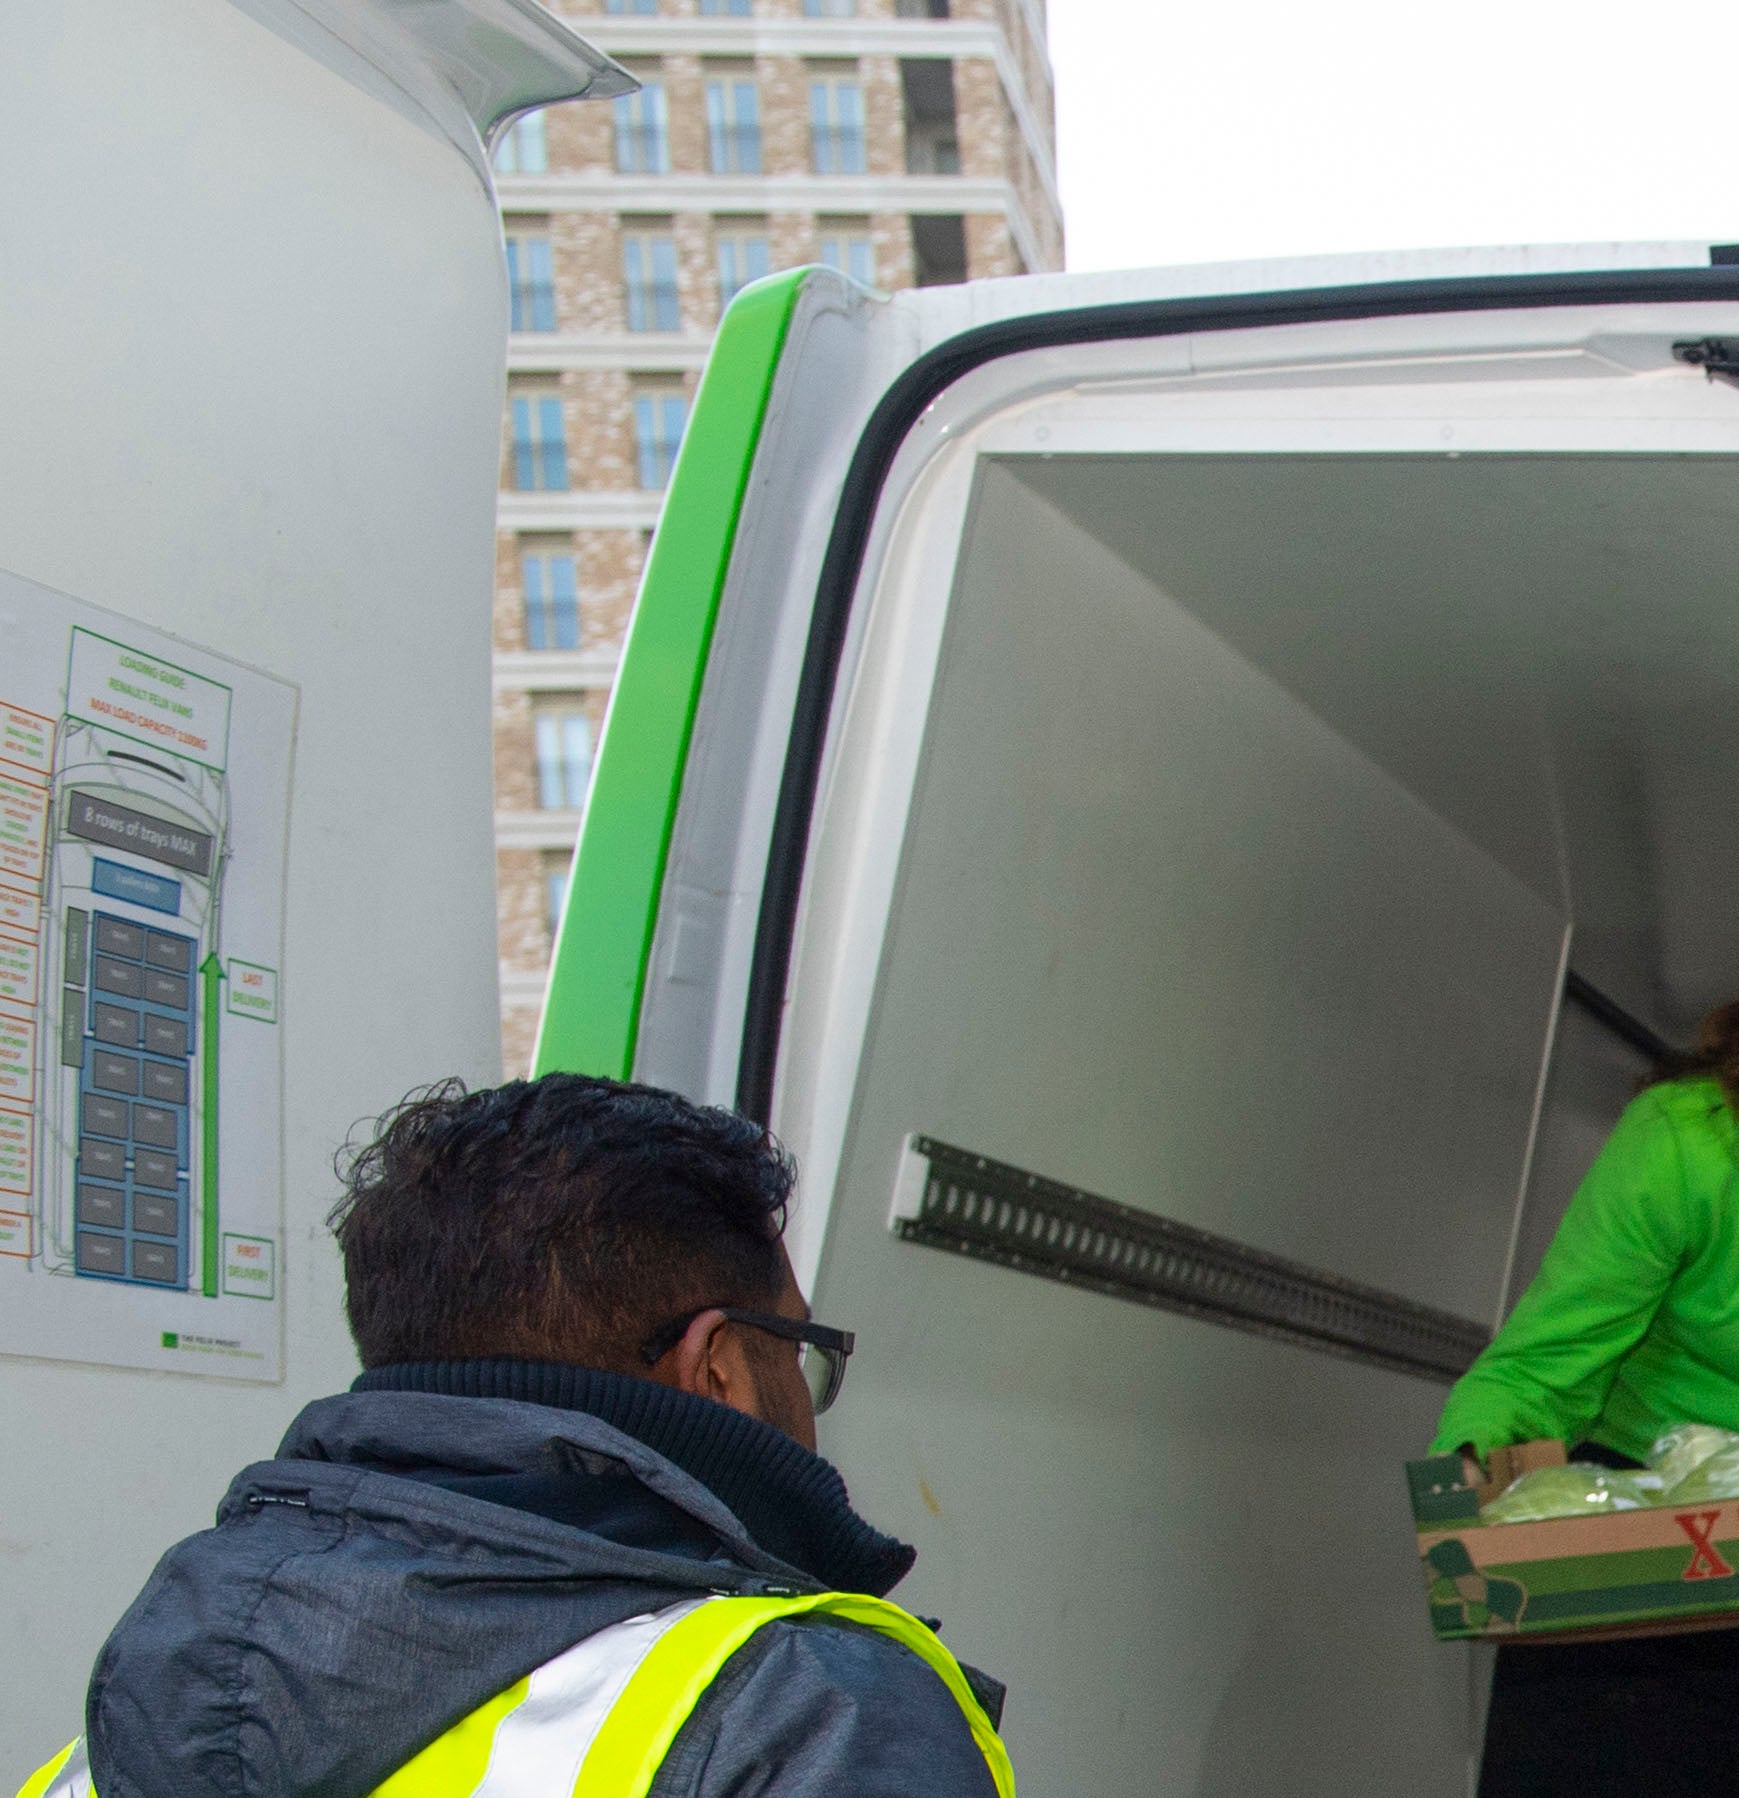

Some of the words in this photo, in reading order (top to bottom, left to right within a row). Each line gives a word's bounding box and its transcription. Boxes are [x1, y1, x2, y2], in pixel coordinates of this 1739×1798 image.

[95, 814, 124, 833] rows
[127, 821, 138, 836] of
[140, 826, 168, 848] trays
[170, 834, 197, 856] MAX
